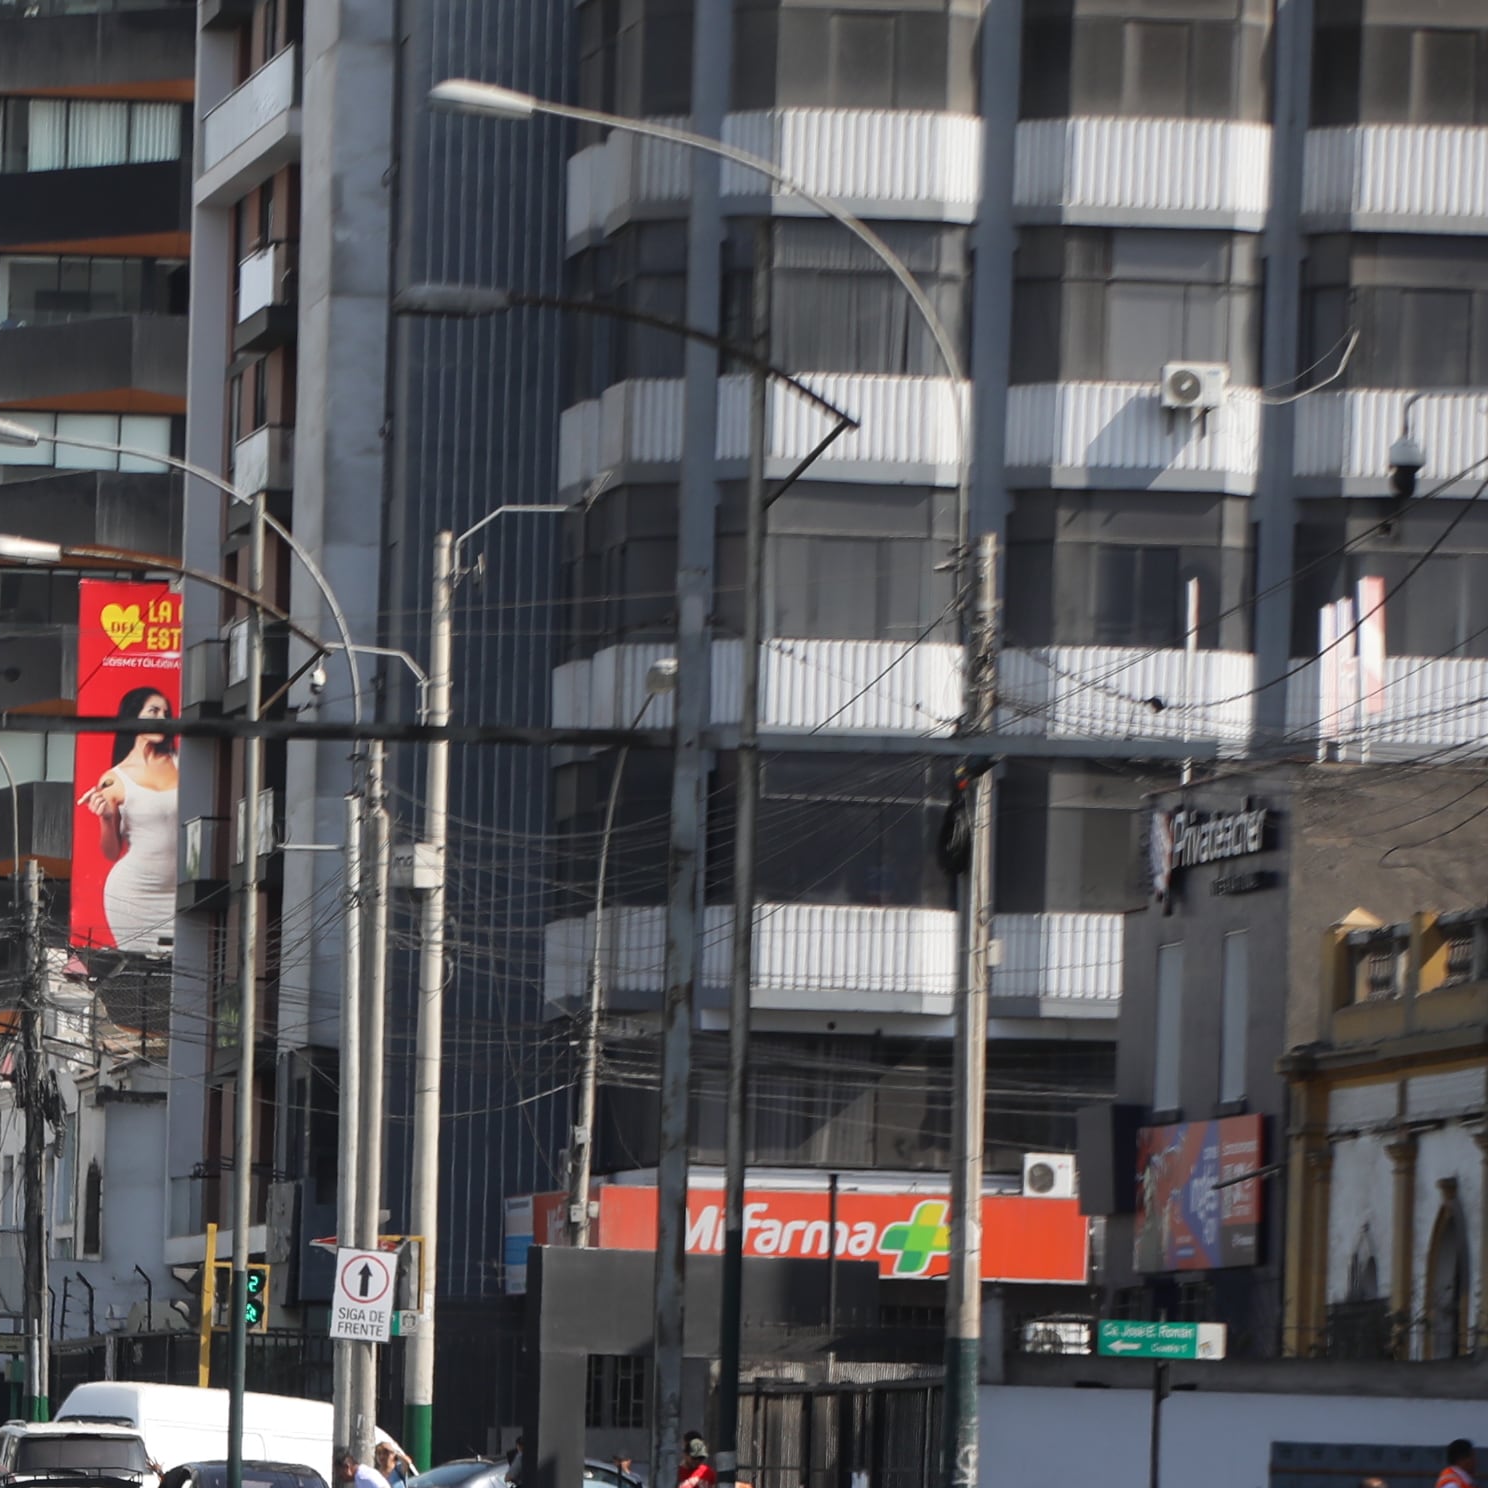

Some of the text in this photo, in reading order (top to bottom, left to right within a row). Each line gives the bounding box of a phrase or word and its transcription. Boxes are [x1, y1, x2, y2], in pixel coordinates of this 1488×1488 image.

[148, 599, 172, 623] LA
[684, 1202, 876, 1257] Mifarma
[338, 1307, 385, 1323] SIGA DE
[337, 1321, 384, 1337] FRENTE
